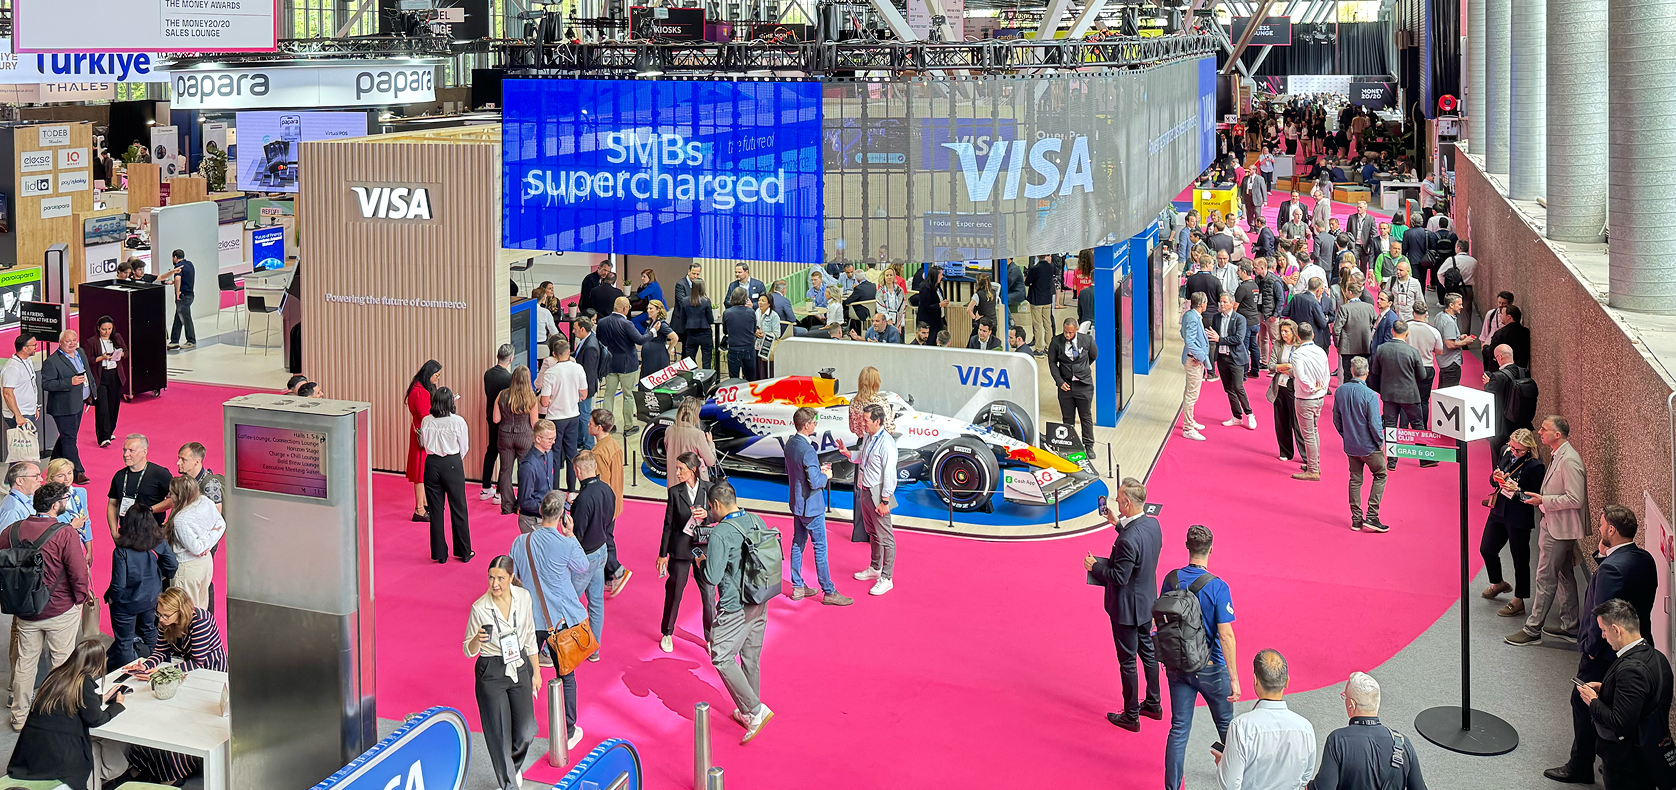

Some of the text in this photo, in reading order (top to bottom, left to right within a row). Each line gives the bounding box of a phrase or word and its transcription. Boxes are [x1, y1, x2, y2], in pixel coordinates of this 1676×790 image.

[182, 0, 209, 8] MONEY
[182, 20, 231, 28] MONEY20/20
[46, 82, 109, 92] THALES
[177, 70, 432, 103] papara papara
[606, 132, 703, 166] SMBs
[941, 136, 1094, 201] VISA
[25, 179, 49, 190] lidio
[528, 162, 785, 209] supercharged
[350, 186, 432, 219] VISA
[90, 258, 118, 275] lidio
[326, 293, 466, 309] Powering the future of commerce
[648, 368, 669, 387] Red
[667, 360, 689, 377] Bll
[952, 365, 1011, 389] VISA
[752, 417, 786, 426] HONDA
[909, 428, 939, 436] HUGO
[286, 466, 305, 474] Meeting
